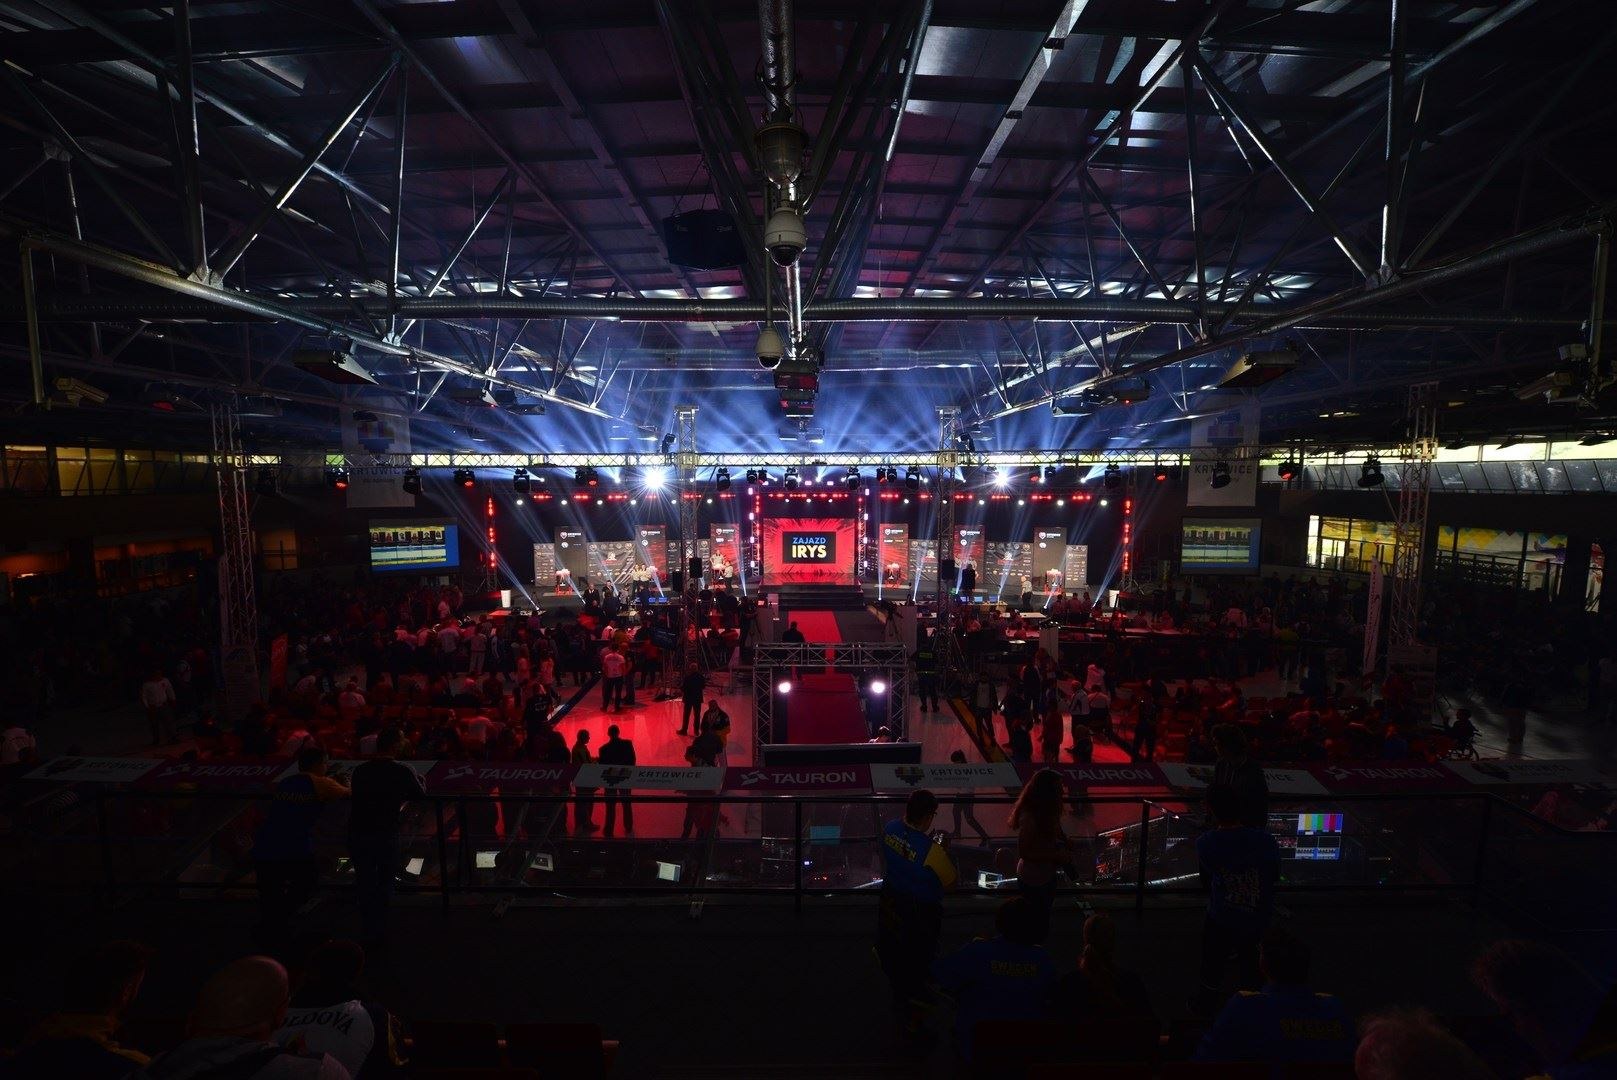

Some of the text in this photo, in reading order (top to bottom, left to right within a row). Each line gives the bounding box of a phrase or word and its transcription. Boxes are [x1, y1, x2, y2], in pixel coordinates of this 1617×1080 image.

[1195, 465, 1252, 474] KAWICE
[792, 537, 826, 545] ZAJAZD
[792, 545, 827, 558] IRYS
[191, 765, 280, 777] TAURON
[478, 769, 564, 780] TAURON
[638, 770, 704, 778] KATOWICE
[930, 767, 994, 776] KATOWICE
[1064, 768, 1153, 781] TAURON
[1351, 768, 1446, 779] TAURON
[770, 771, 857, 784] TAURON
